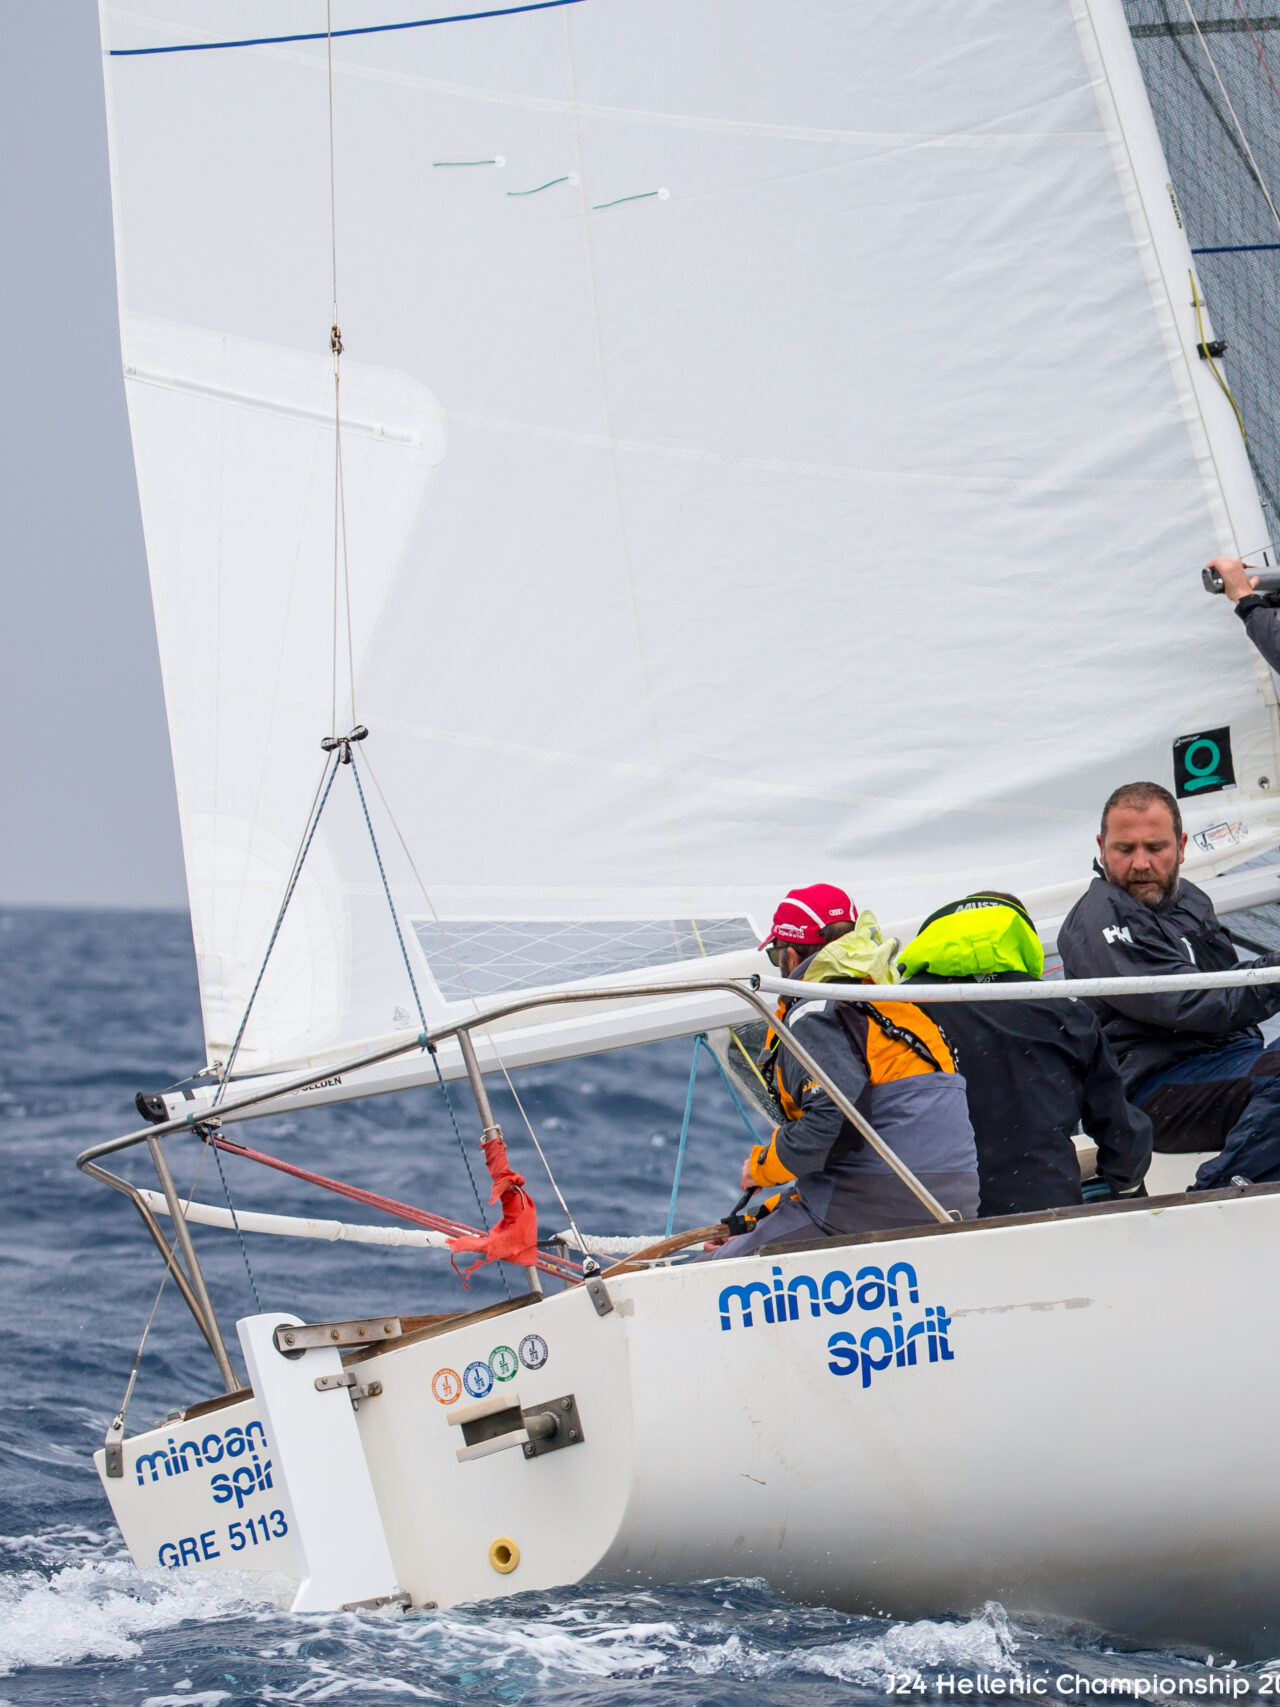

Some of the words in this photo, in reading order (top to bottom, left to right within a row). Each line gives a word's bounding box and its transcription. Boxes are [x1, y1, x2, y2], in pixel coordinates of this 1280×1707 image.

[718, 1261, 920, 1331] minoan
[827, 1305, 954, 1389] spirit
[135, 1420, 268, 1486] minoan
[210, 1454, 273, 1509] spir
[158, 1529, 221, 1569] GRE
[228, 1509, 289, 1551] 5113
